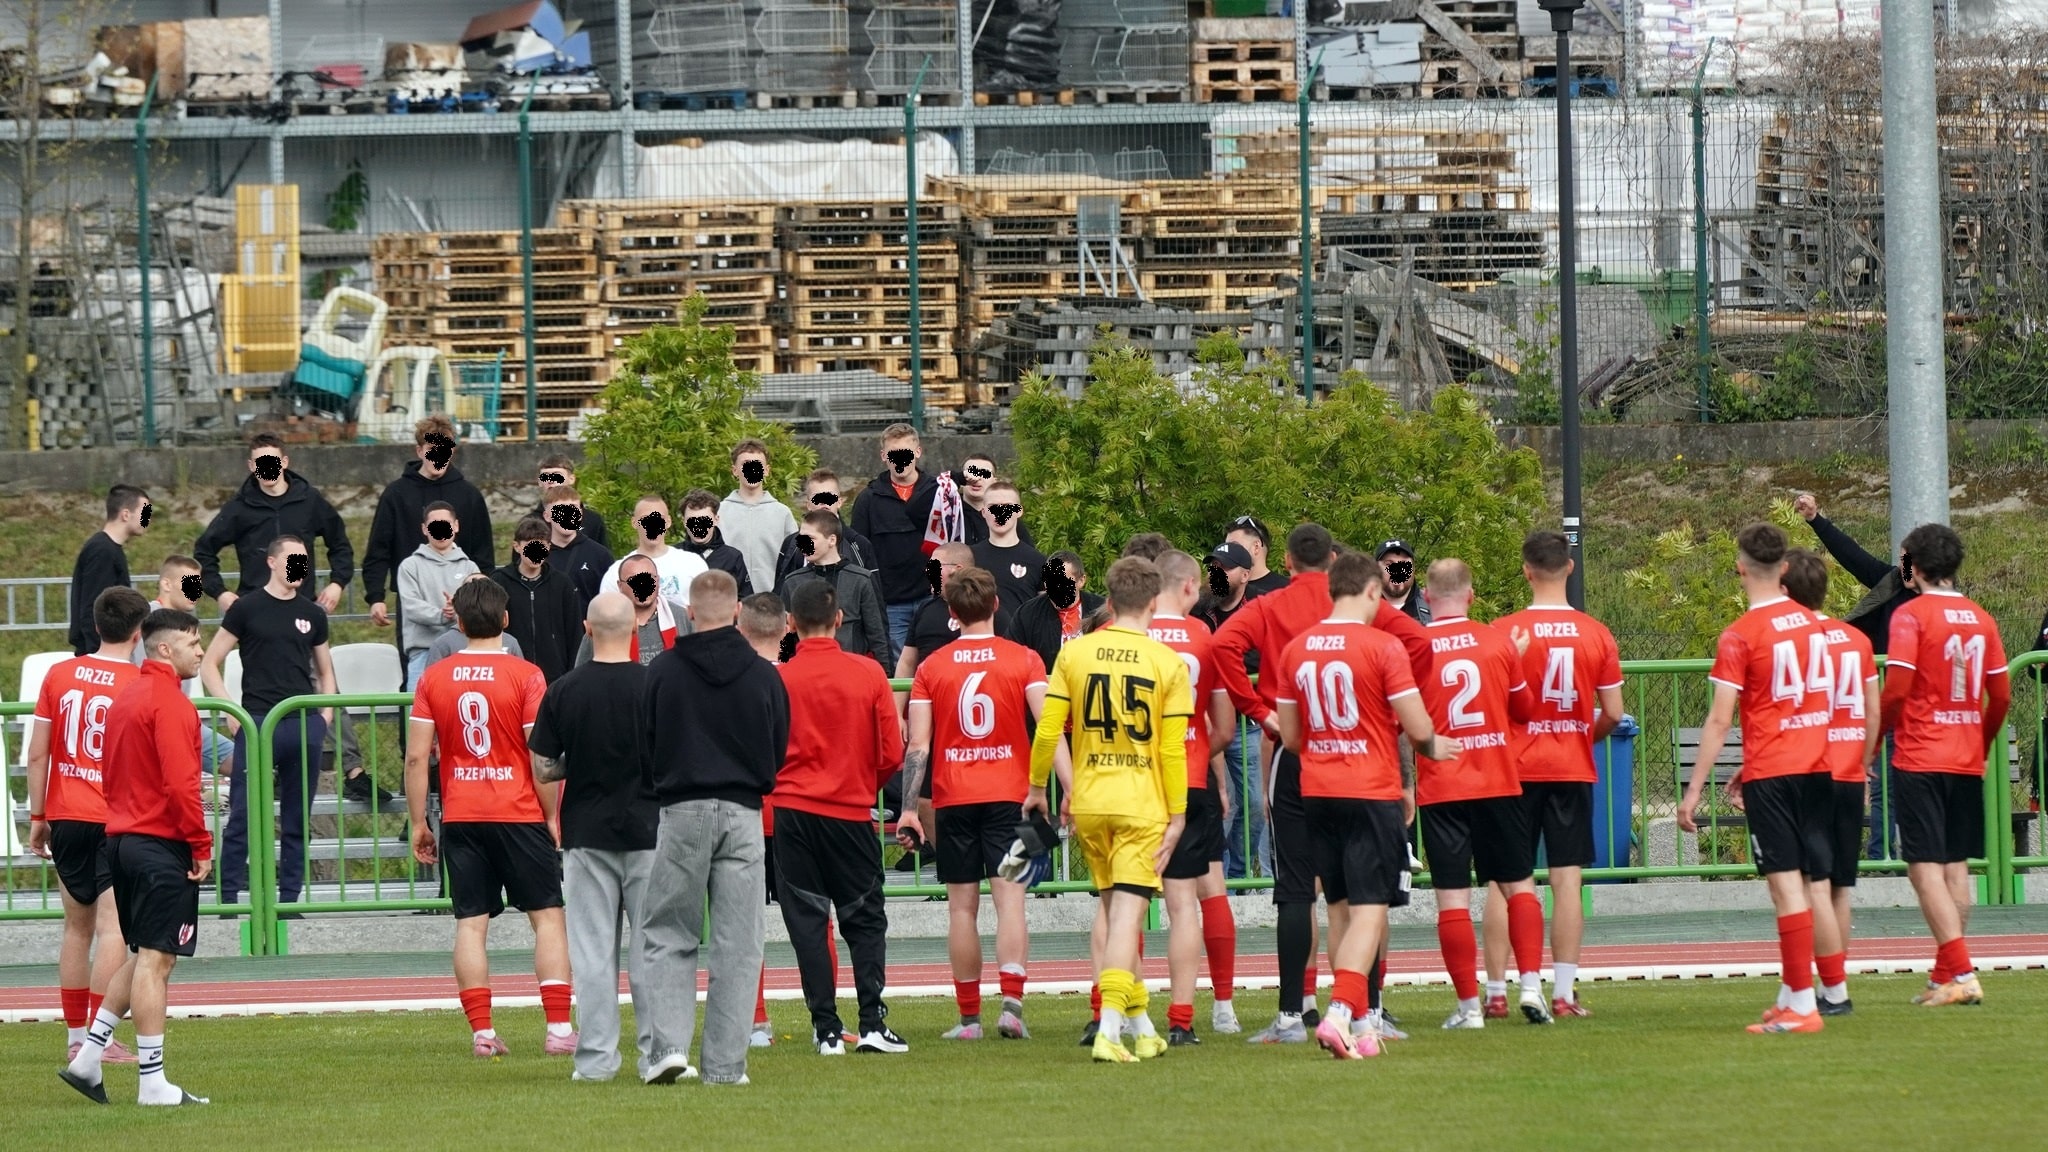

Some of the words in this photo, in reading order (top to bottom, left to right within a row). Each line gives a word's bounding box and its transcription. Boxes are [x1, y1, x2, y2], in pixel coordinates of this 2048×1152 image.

[1771, 611, 1811, 632] ORZEŁ
[1944, 609, 1979, 624] ORZEŁ
[1534, 622, 1579, 638] ORZEŁ
[1306, 635, 1345, 650] ORZEŁ
[1432, 633, 1479, 653] ORZEŁ
[953, 647, 996, 663] ORZEŁ
[1096, 647, 1139, 663] ORZEŁ
[75, 666, 115, 686] ORZEŁ
[453, 666, 495, 681] ORZEŁ
[1944, 633, 1986, 702] 11
[1542, 647, 1578, 713] 4
[958, 670, 995, 739] 6
[1296, 660, 1359, 732] 10
[1441, 659, 1485, 731] 2
[1083, 673, 1156, 745] 45
[60, 689, 113, 761] 18
[458, 691, 491, 759] 8
[1457, 732, 1506, 750] EWORSK
[945, 745, 1012, 762] PRZEWORSK
[58, 762, 103, 783] PRZEWOR
